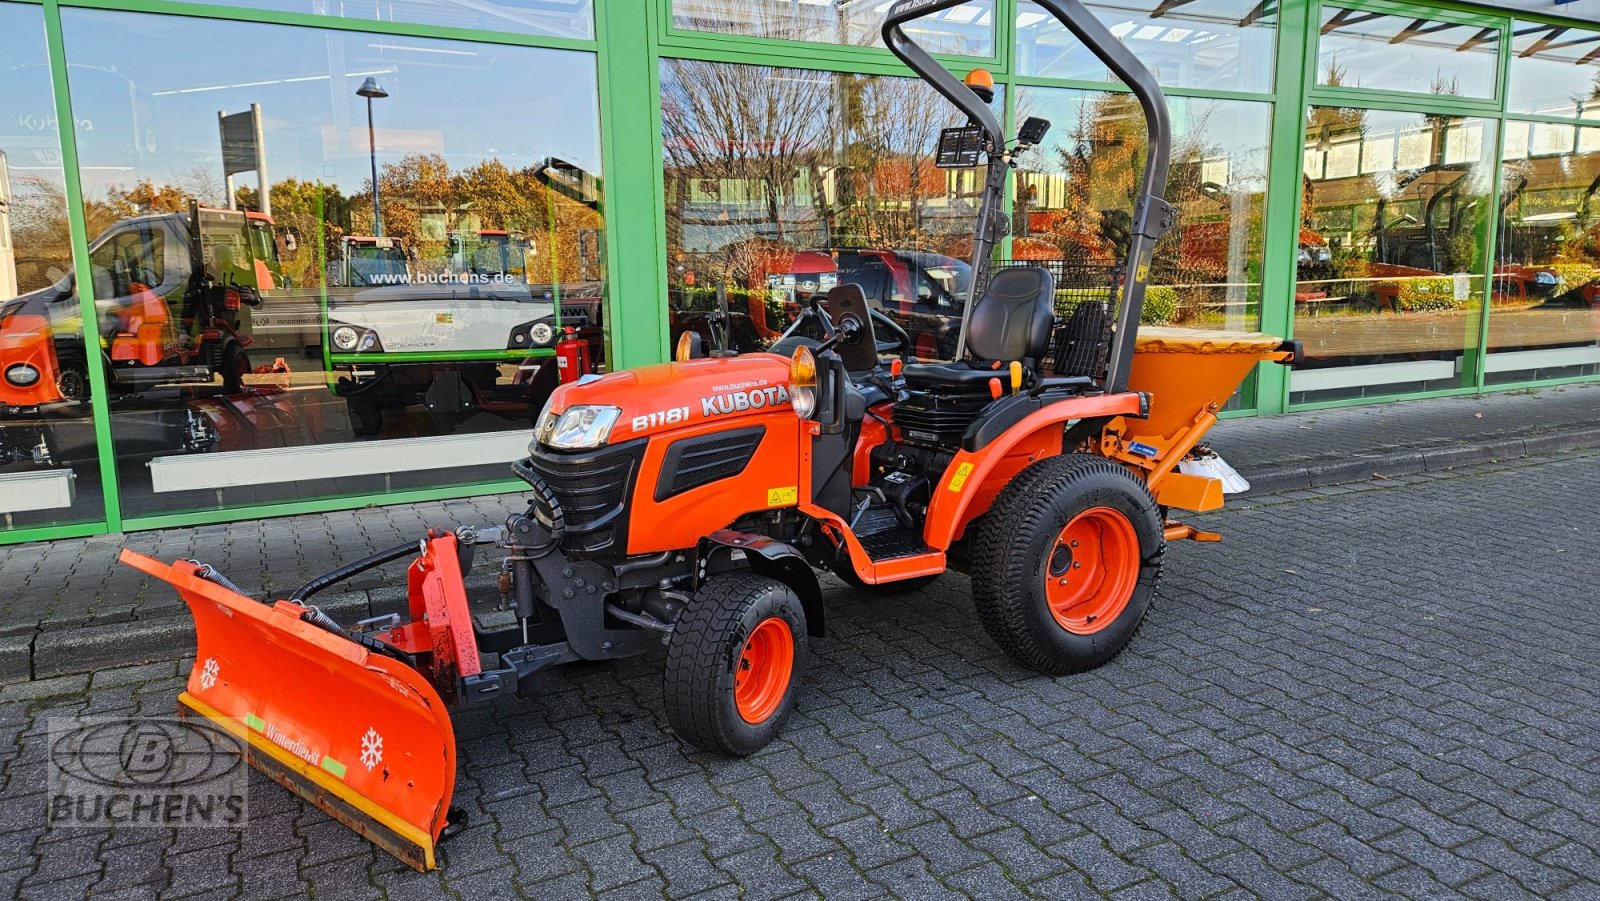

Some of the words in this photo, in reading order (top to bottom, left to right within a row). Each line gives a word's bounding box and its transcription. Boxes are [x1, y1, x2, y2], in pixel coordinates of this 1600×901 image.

[18, 113, 94, 131] Kubta
[712, 378, 768, 392] www.buchens.de
[701, 384, 791, 417] KUBOTA
[631, 406, 690, 433] B1181
